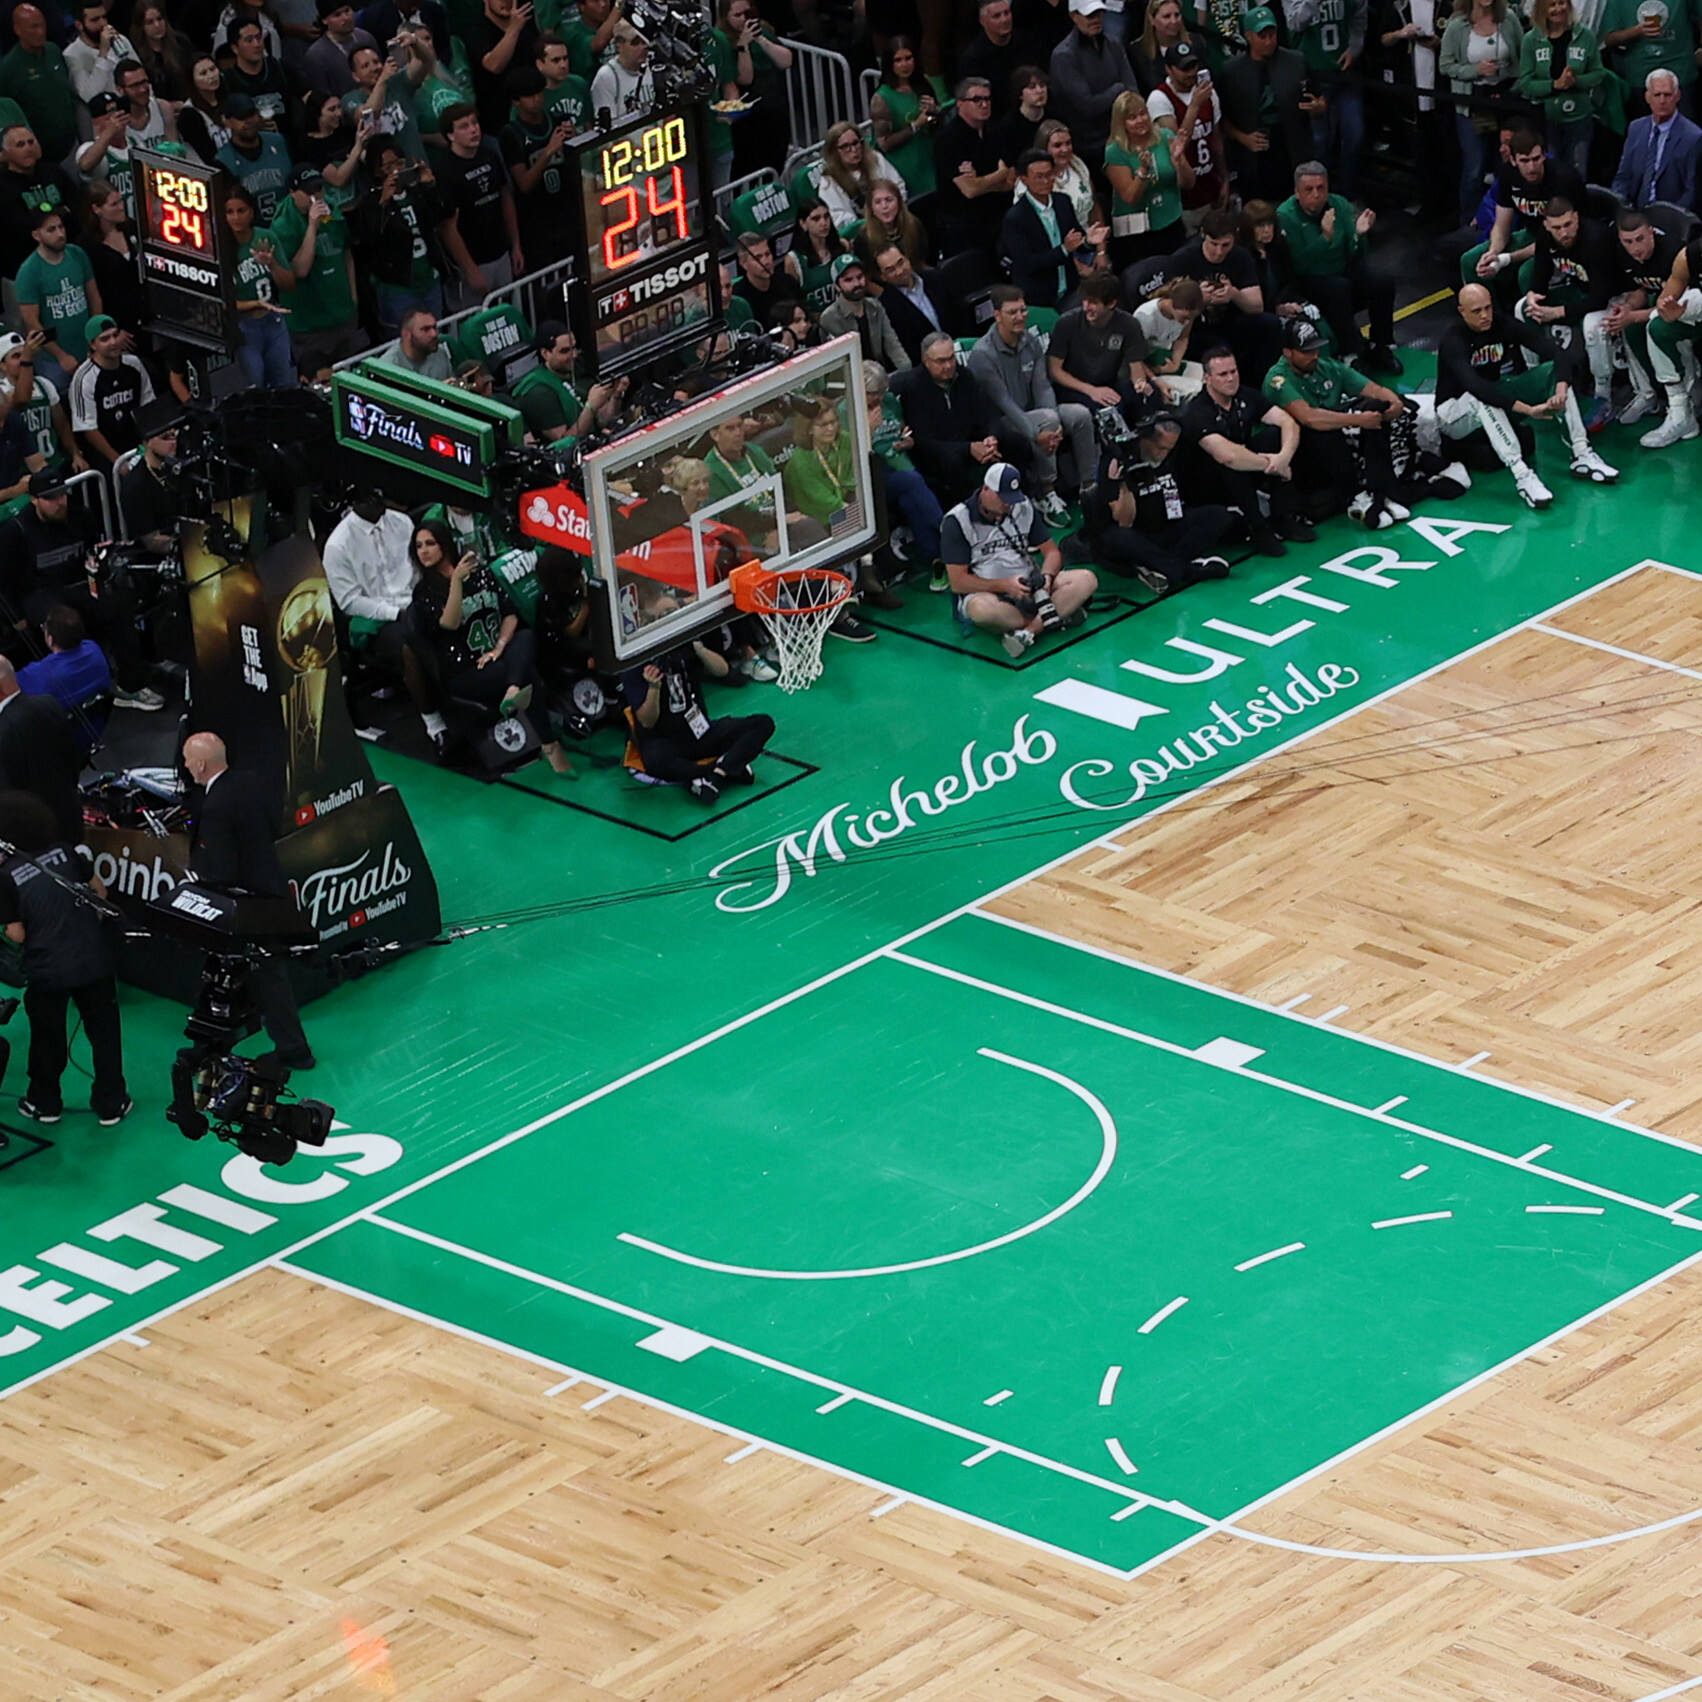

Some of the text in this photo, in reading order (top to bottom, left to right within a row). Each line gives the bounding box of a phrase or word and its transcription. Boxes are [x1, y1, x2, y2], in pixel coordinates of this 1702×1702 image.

[1321, 24, 1340, 52] 0
[603, 117, 687, 190] 12:00
[1197, 140, 1211, 164] 6
[157, 171, 208, 212] 12:00
[752, 190, 790, 224] BOSTON
[162, 203, 203, 249] 24
[601, 166, 690, 270] 24
[166, 261, 218, 288] TISSOT
[629, 253, 709, 306] TISSOT
[481, 323, 521, 355] BOSTON
[38, 429, 55, 458] 0
[366, 403, 424, 450] Finals
[241, 625, 258, 647] GET
[244, 645, 262, 668] THE
[708, 514, 1512, 913] Michelob ULTRA
[1059, 662, 1360, 812] Courtside
[302, 842, 411, 928] Finals
[0, 1121, 404, 1357] ELTICS
